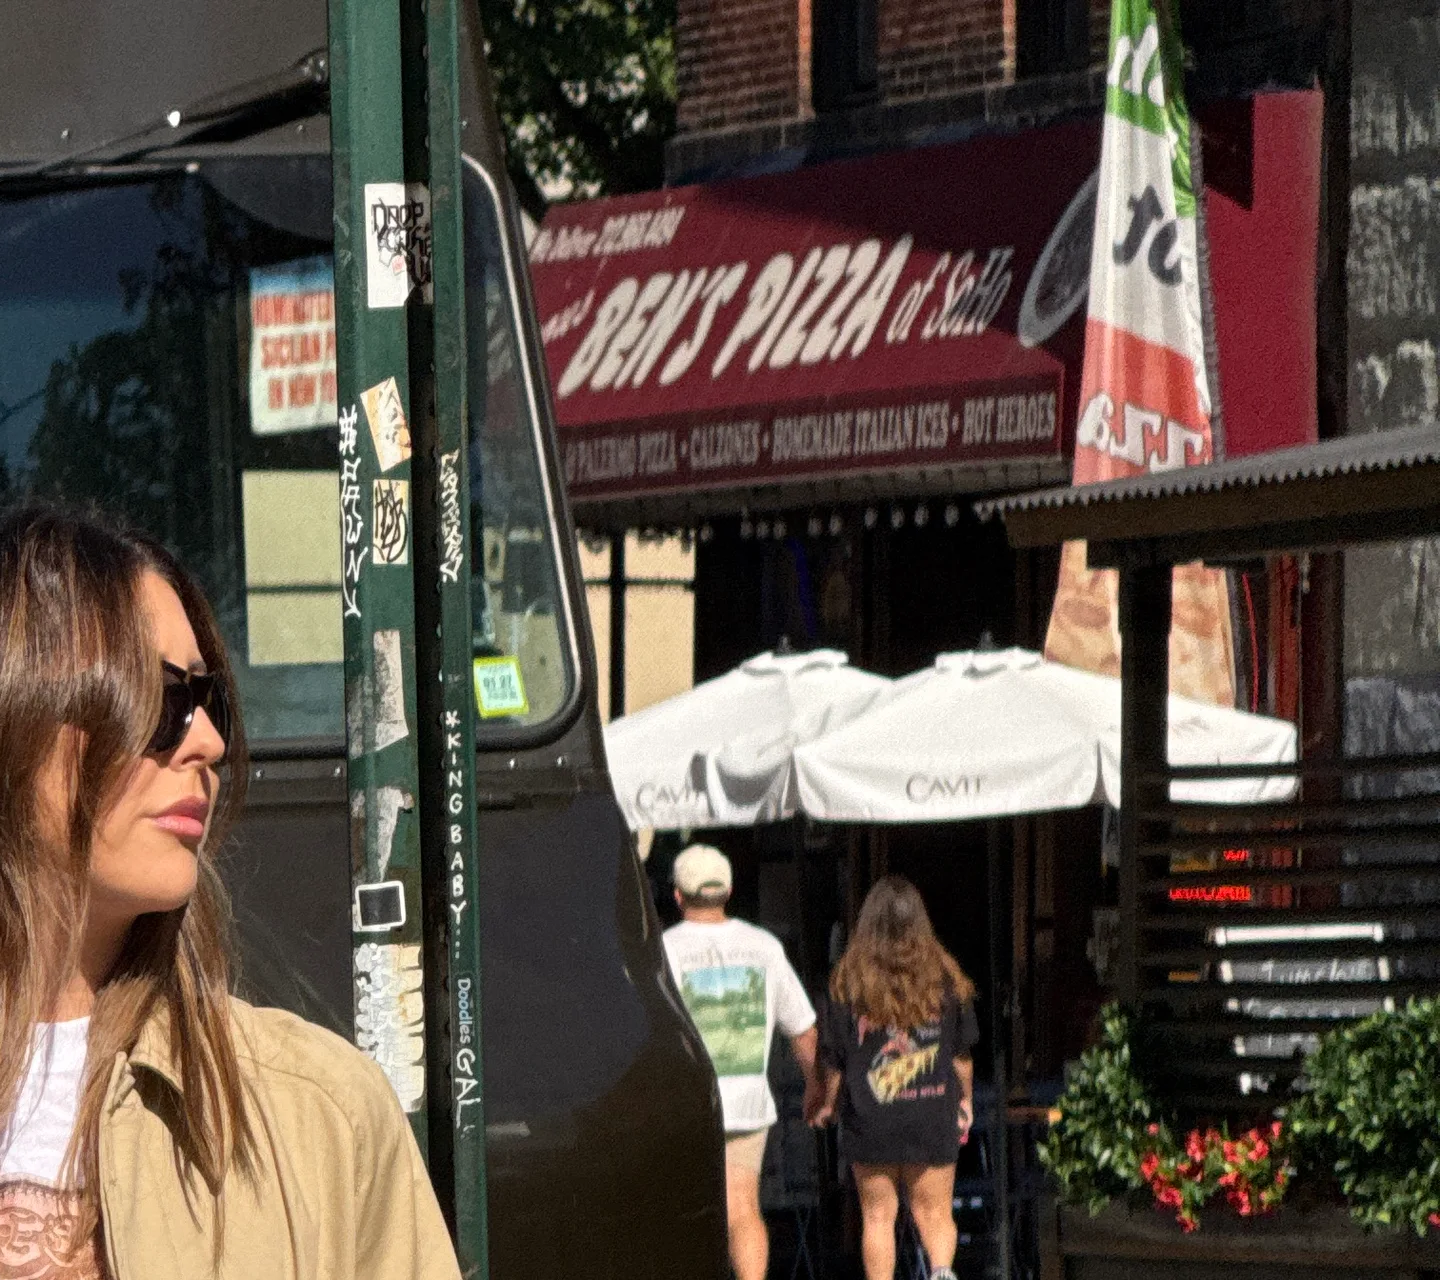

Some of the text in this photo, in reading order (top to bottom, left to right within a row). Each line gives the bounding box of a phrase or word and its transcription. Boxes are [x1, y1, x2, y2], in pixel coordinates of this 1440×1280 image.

[558, 260, 749, 398] BEN'S
[713, 233, 914, 379] PIZZA
[886, 251, 951, 344] of
[637, 429, 678, 474] PIZZA
[688, 421, 761, 470] CALZONES
[771, 410, 853, 462] HOMEMADE
[853, 403, 916, 455] ITALIAN
[915, 399, 950, 449] ICES
[962, 396, 995, 445] HOT
[995, 391, 1057, 443] HEROES
[457, 977, 473, 1044] Doodles
